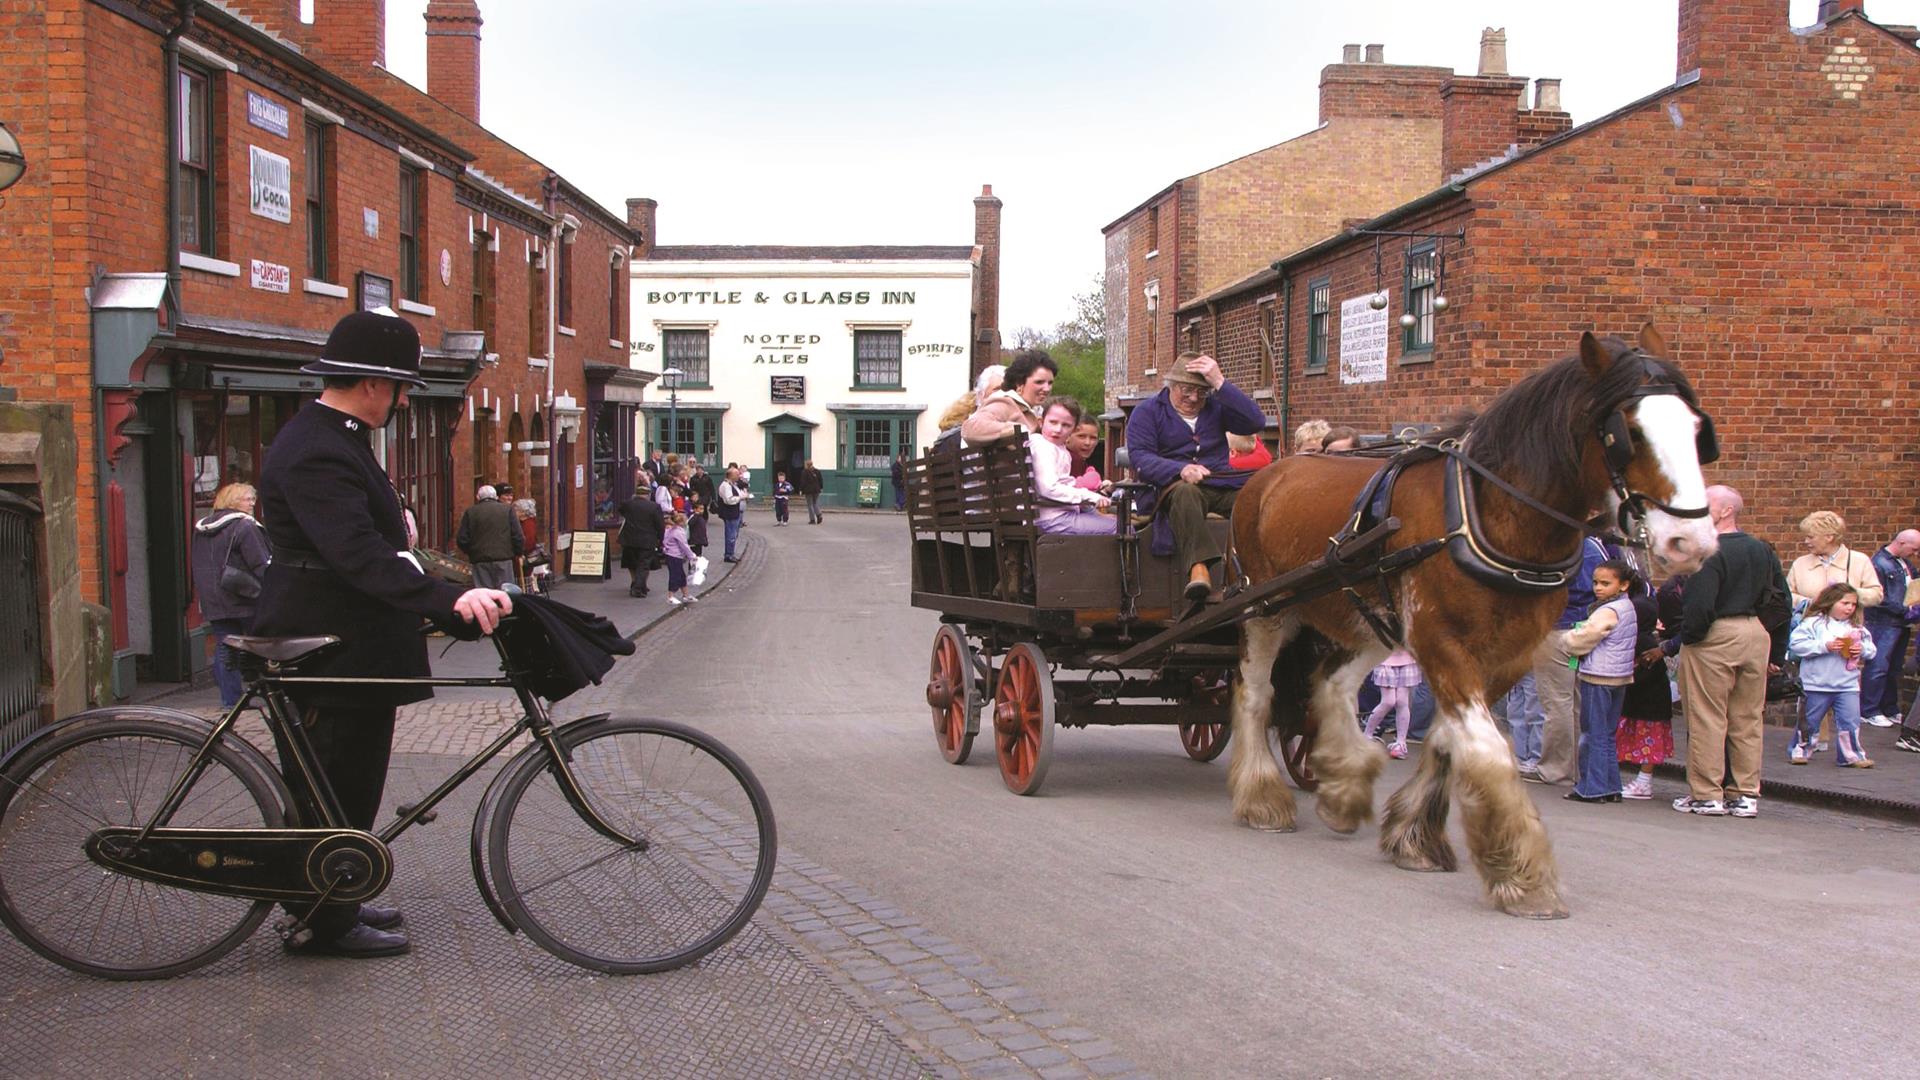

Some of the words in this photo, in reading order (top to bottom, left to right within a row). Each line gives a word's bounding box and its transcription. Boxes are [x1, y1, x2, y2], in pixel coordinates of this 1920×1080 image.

[647, 291, 742, 305] BOTTLE
[754, 291, 770, 305] &
[783, 291, 871, 305] GLASS
[881, 291, 916, 305] INN
[743, 334, 821, 345] NOTED
[908, 343, 964, 355] SPIRITS
[753, 354, 809, 365] ALES
[345, 419, 358, 431] 40
